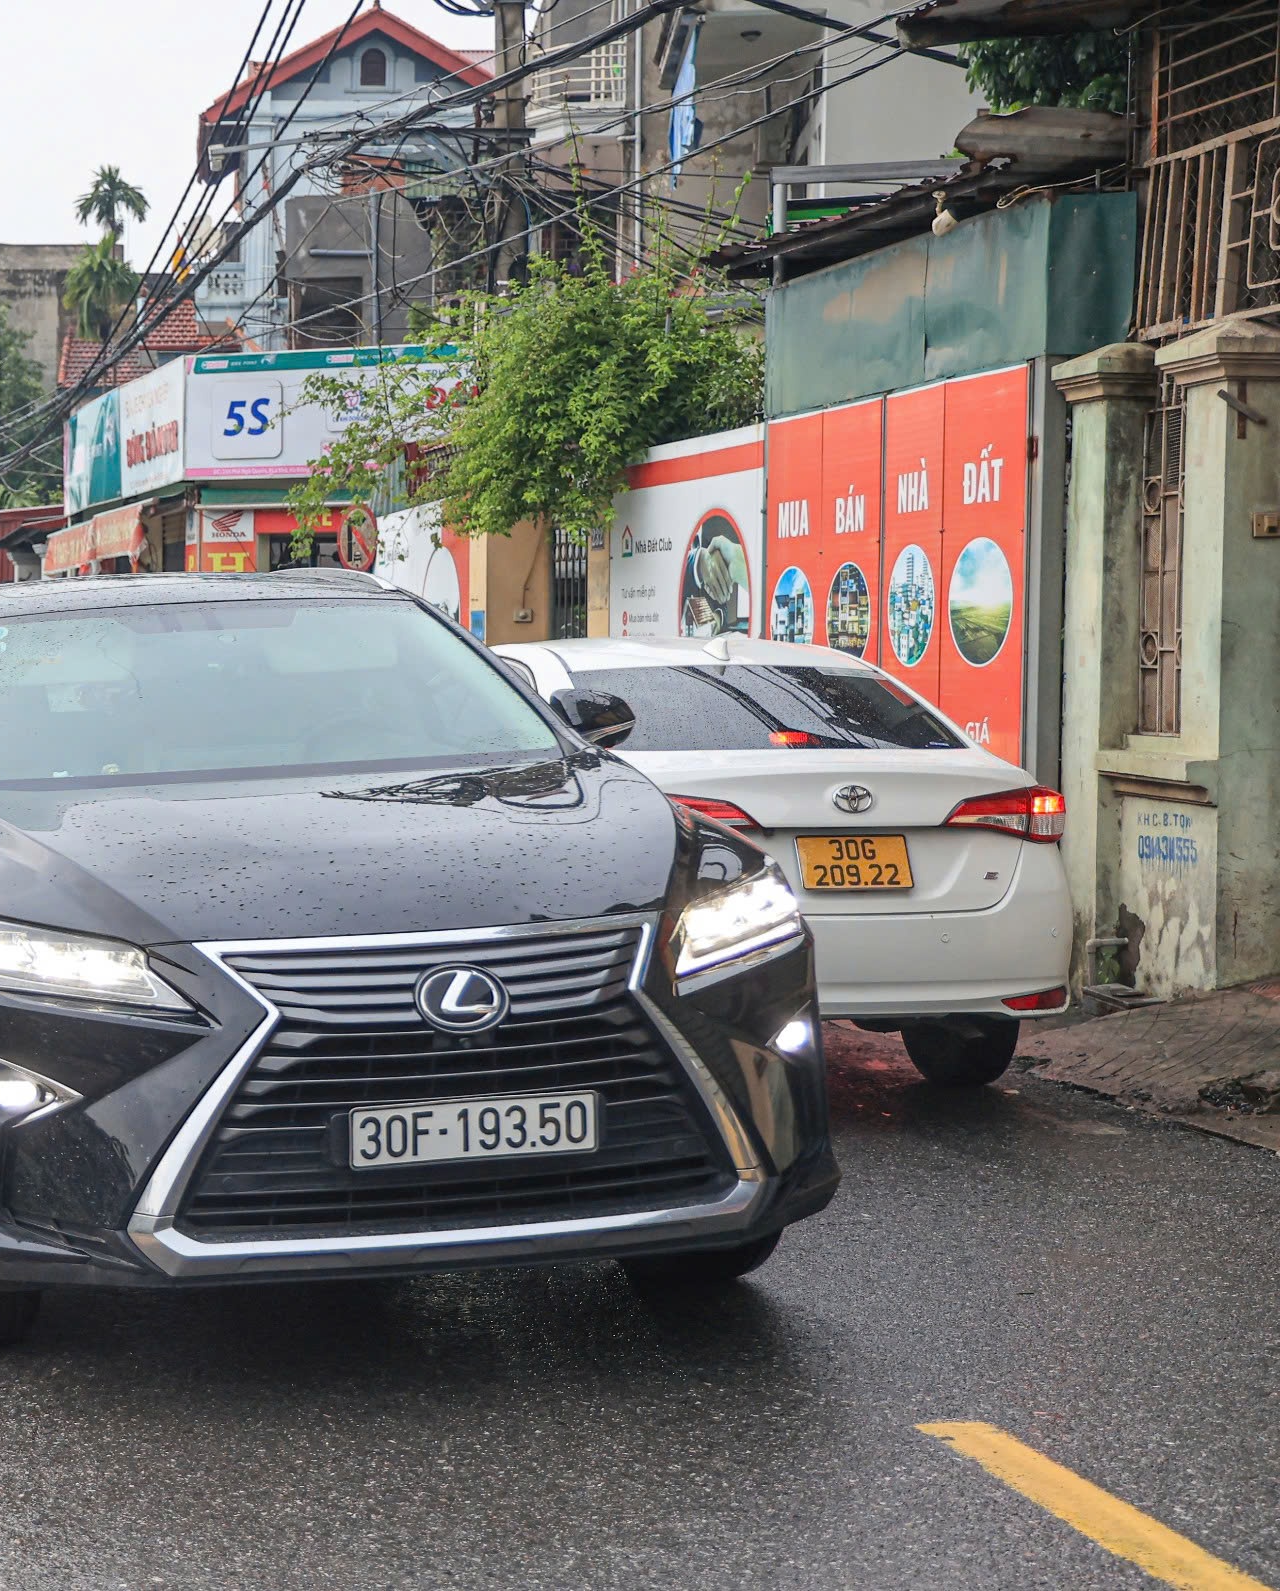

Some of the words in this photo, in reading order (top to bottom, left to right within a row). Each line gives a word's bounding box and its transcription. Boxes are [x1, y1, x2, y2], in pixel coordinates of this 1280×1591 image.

[223, 398, 270, 437] 5S
[778, 500, 809, 538] MUA
[835, 485, 865, 534] BÁN
[897, 458, 929, 514] NHÀ
[963, 444, 1003, 505] ĐẤT
[635, 540, 646, 553] Nhà
[647, 538, 658, 553] Đất
[659, 538, 672, 552] Club
[965, 716, 990, 744] GIÁ
[829, 839, 876, 861] 30G
[813, 863, 901, 886] 209.22
[359, 1100, 587, 1160] 30F-193.50
